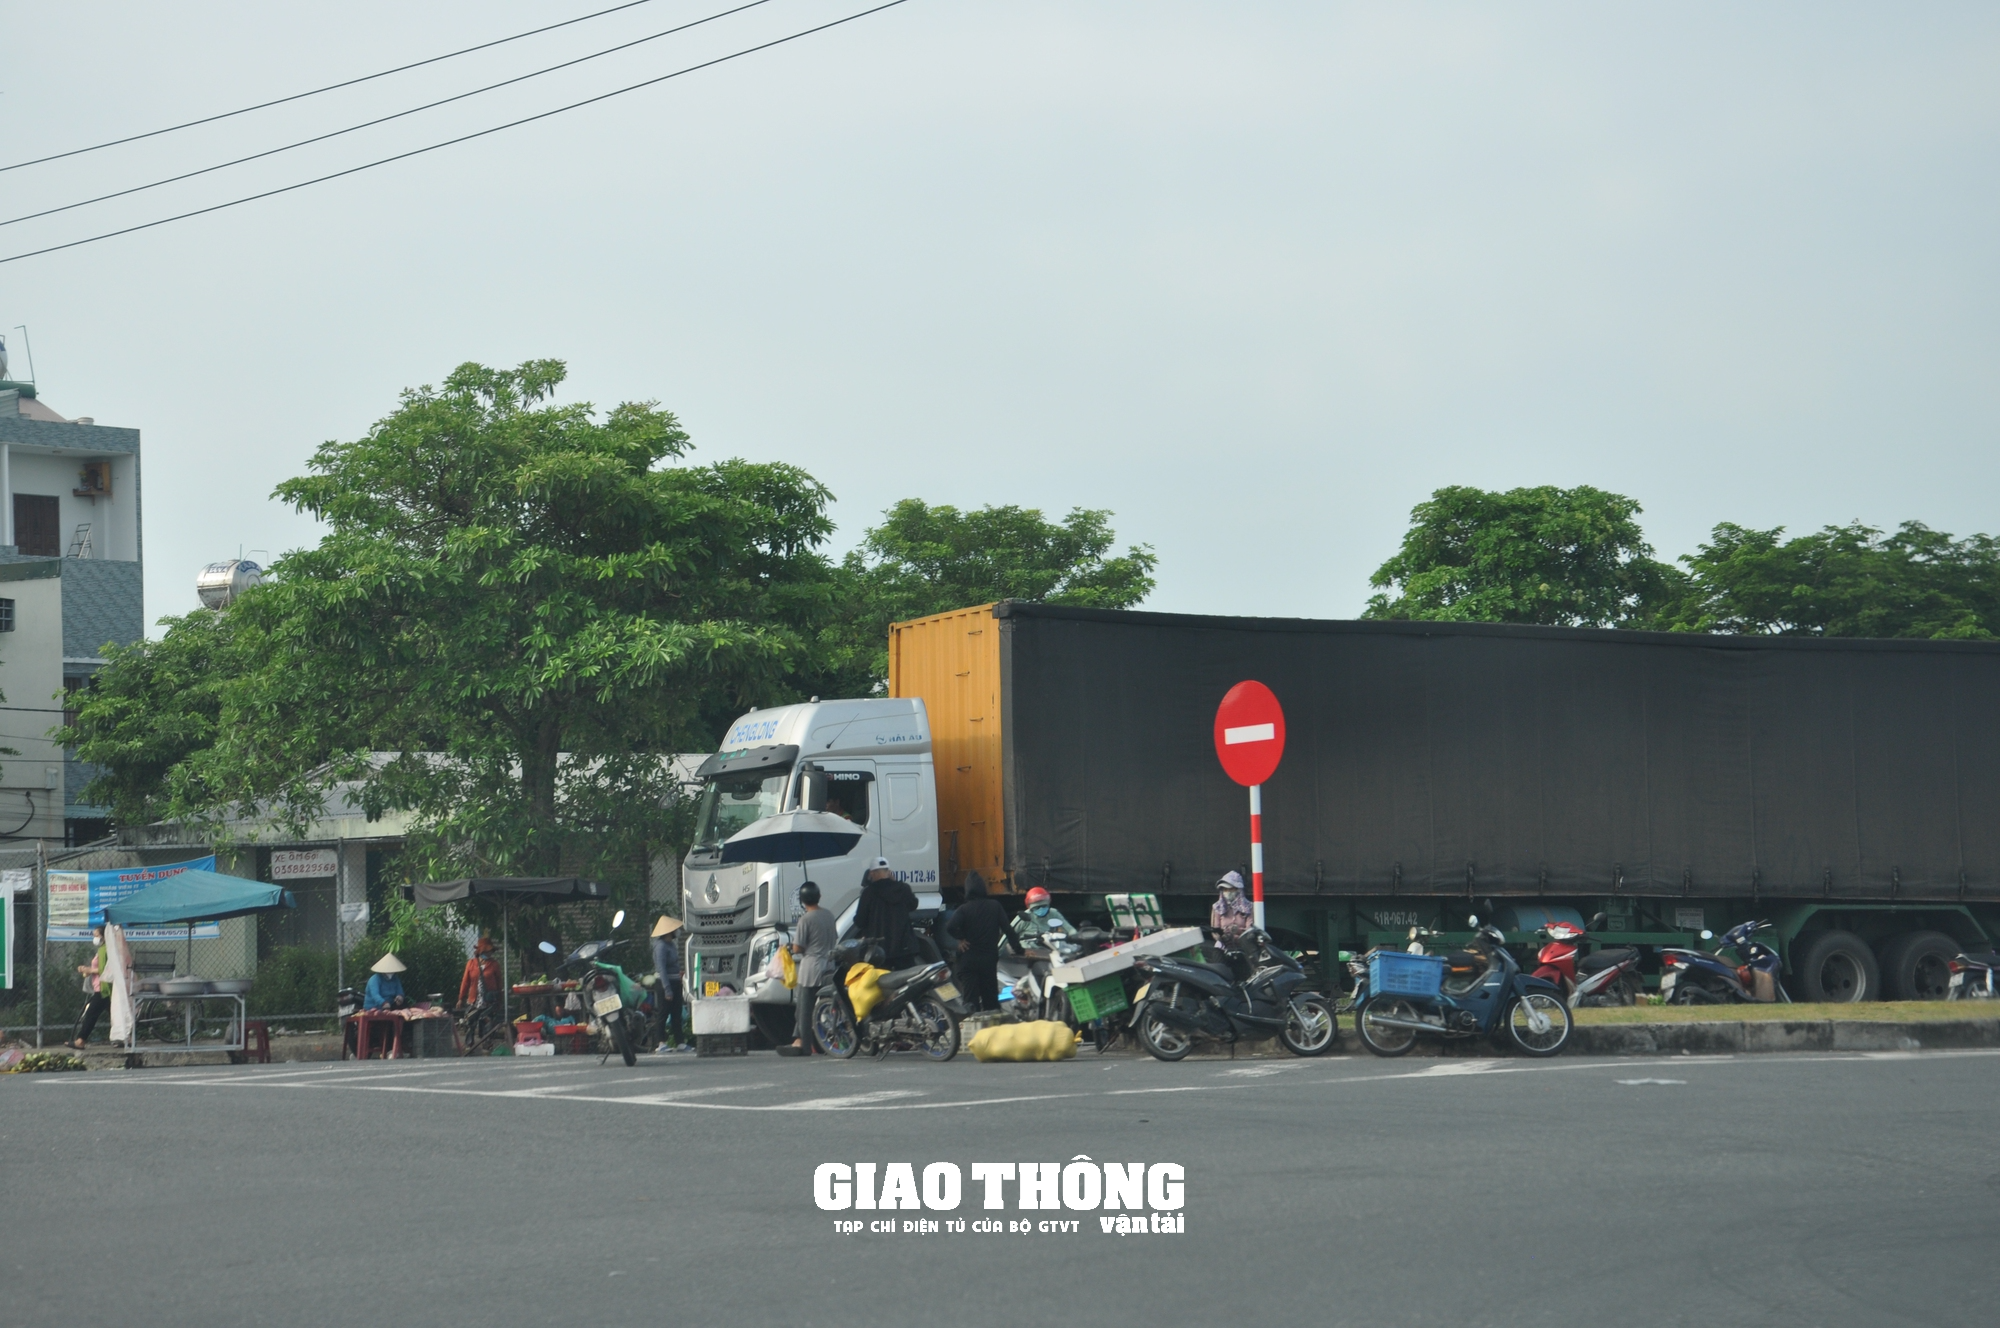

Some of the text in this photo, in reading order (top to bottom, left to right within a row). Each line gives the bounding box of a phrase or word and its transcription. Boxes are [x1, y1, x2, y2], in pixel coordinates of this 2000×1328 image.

[729, 720, 779, 744] CHENGLONG
[833, 773, 861, 781] HINO
[274, 854, 286, 863] XE
